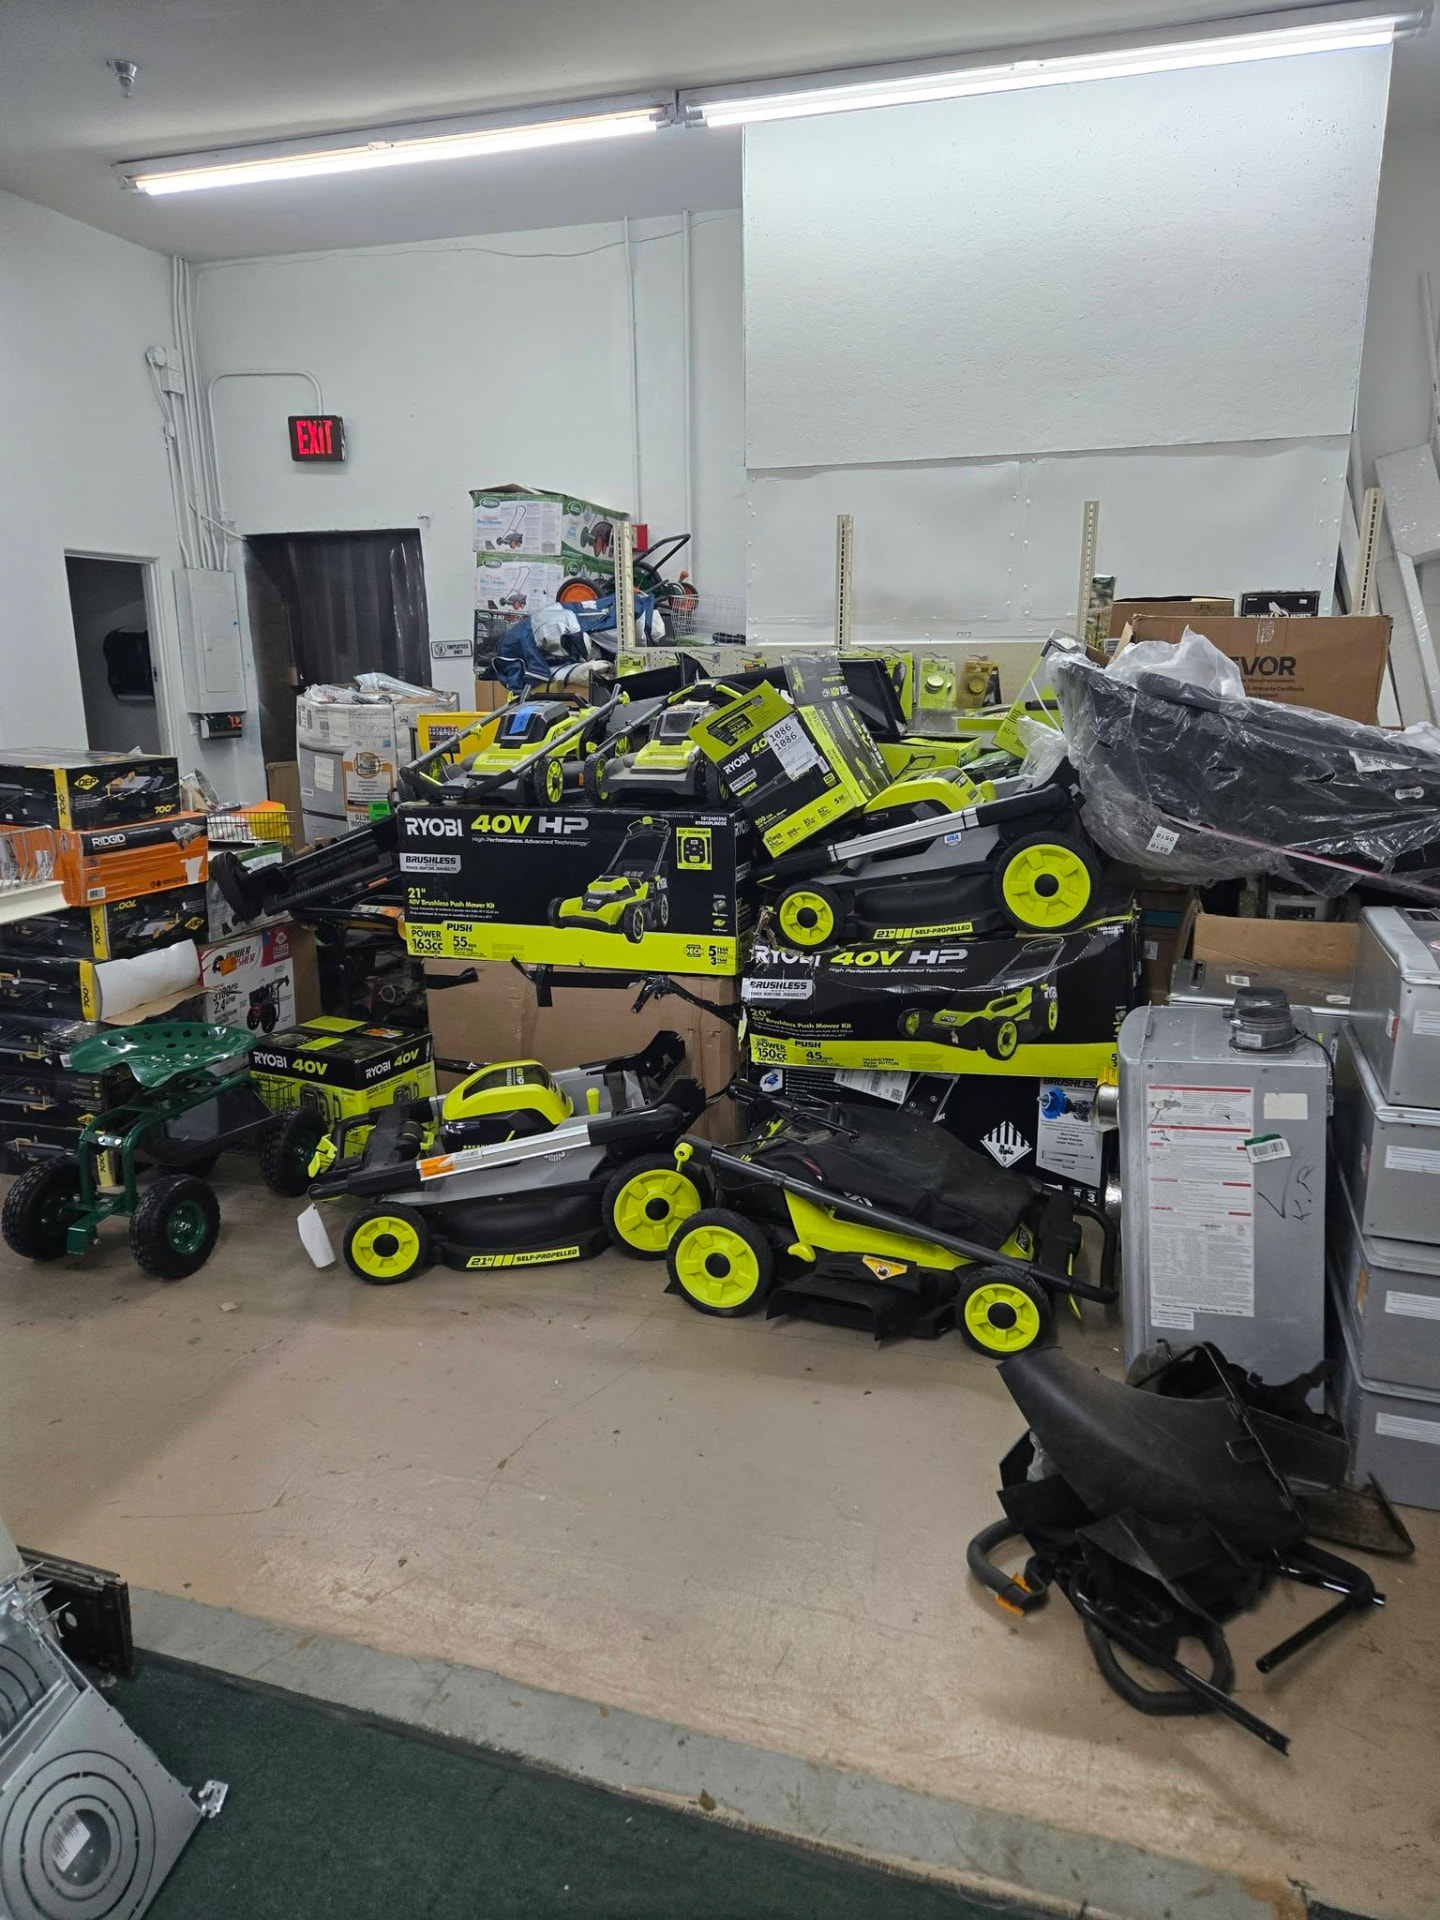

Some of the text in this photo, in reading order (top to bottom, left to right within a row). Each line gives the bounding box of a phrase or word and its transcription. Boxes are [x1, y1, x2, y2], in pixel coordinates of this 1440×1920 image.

[296, 420, 332, 454] EXIT
[1229, 656, 1297, 676] VOR
[769, 723, 793, 742] 1086
[775, 731, 799, 751] 1086
[722, 737, 769, 775] RYOBI 40
[78, 777, 97, 787] QEP
[405, 814, 589, 837] RYOBI 40V HP
[91, 833, 127, 848] RIDGID
[524, 838, 554, 846] Advanced
[405, 855, 457, 865] BRUSHLESS
[408, 887, 426, 899] 21"
[421, 899, 449, 907] Brushless
[450, 900, 465, 908] Push
[465, 901, 486, 909] Mower
[446, 923, 473, 932] PUSH
[877, 923, 971, 938] 21" SELF-PROPELLED
[411, 929, 442, 939] POWER
[412, 938, 444, 951] 163cc
[453, 936, 468, 947] 55
[708, 945, 717, 957] 5
[710, 956, 717, 966] 3
[829, 950, 905, 967] 40V
[908, 948, 968, 965] HP
[750, 980, 808, 990] BRUSHLESS
[749, 1007, 771, 1018] 20"
[797, 1021, 815, 1029] Push
[756, 1041, 786, 1052] POWER
[794, 1040, 822, 1049] PUSH
[757, 1048, 788, 1060] 150cc
[805, 1051, 823, 1061] 45
[253, 1051, 328, 1076] RYOBI 40V
[365, 1048, 420, 1080] RYOBI 40V
[1043, 1077, 1097, 1090] BRUSHLES
[471, 1247, 578, 1266] 21" SELF-PROPELLED
